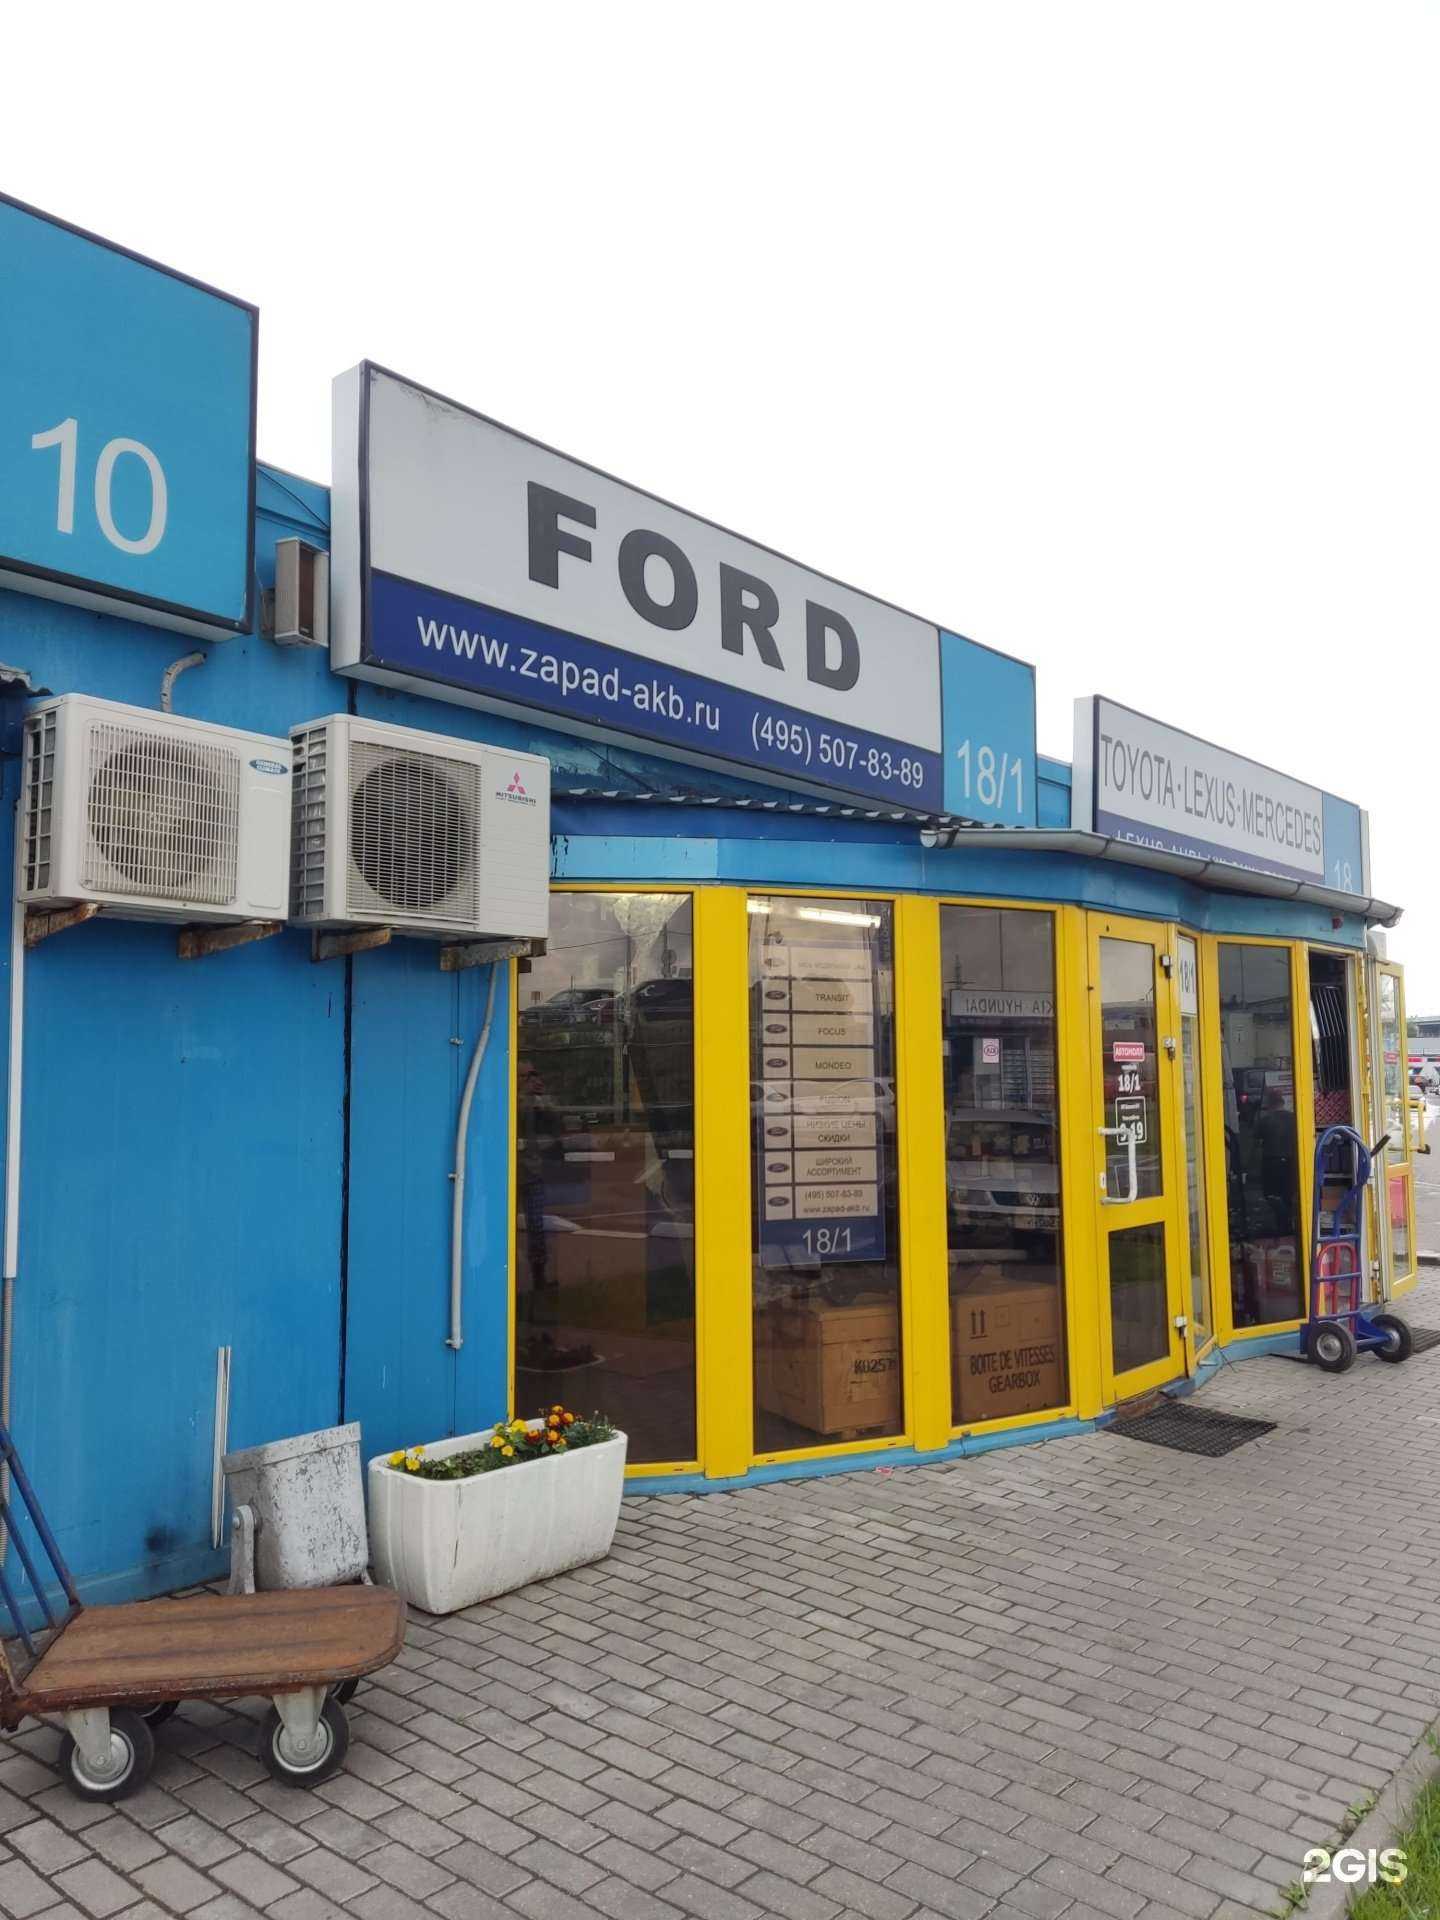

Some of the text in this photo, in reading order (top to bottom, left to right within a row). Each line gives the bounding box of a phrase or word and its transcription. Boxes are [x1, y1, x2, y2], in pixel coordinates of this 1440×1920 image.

[32, 417, 168, 556] 10
[527, 480, 861, 692] FORD
[416, 615, 720, 731] www.zapad-akb.ru
[752, 711, 924, 790] (495) 507-83-89
[957, 739, 1024, 814] 18/1
[816, 993, 849, 1001] TRANSIT
[818, 1027, 847, 1035] FOCUS
[816, 1061, 852, 1070] MONDEO
[1118, 1074, 1141, 1093] 18/1
[807, 1167, 862, 1177] АССОРТИМЕНТ
[802, 1226, 851, 1255] 18/1
[999, 1350, 1013, 1370] DE
[989, 1371, 1041, 1394] GEARBOX
